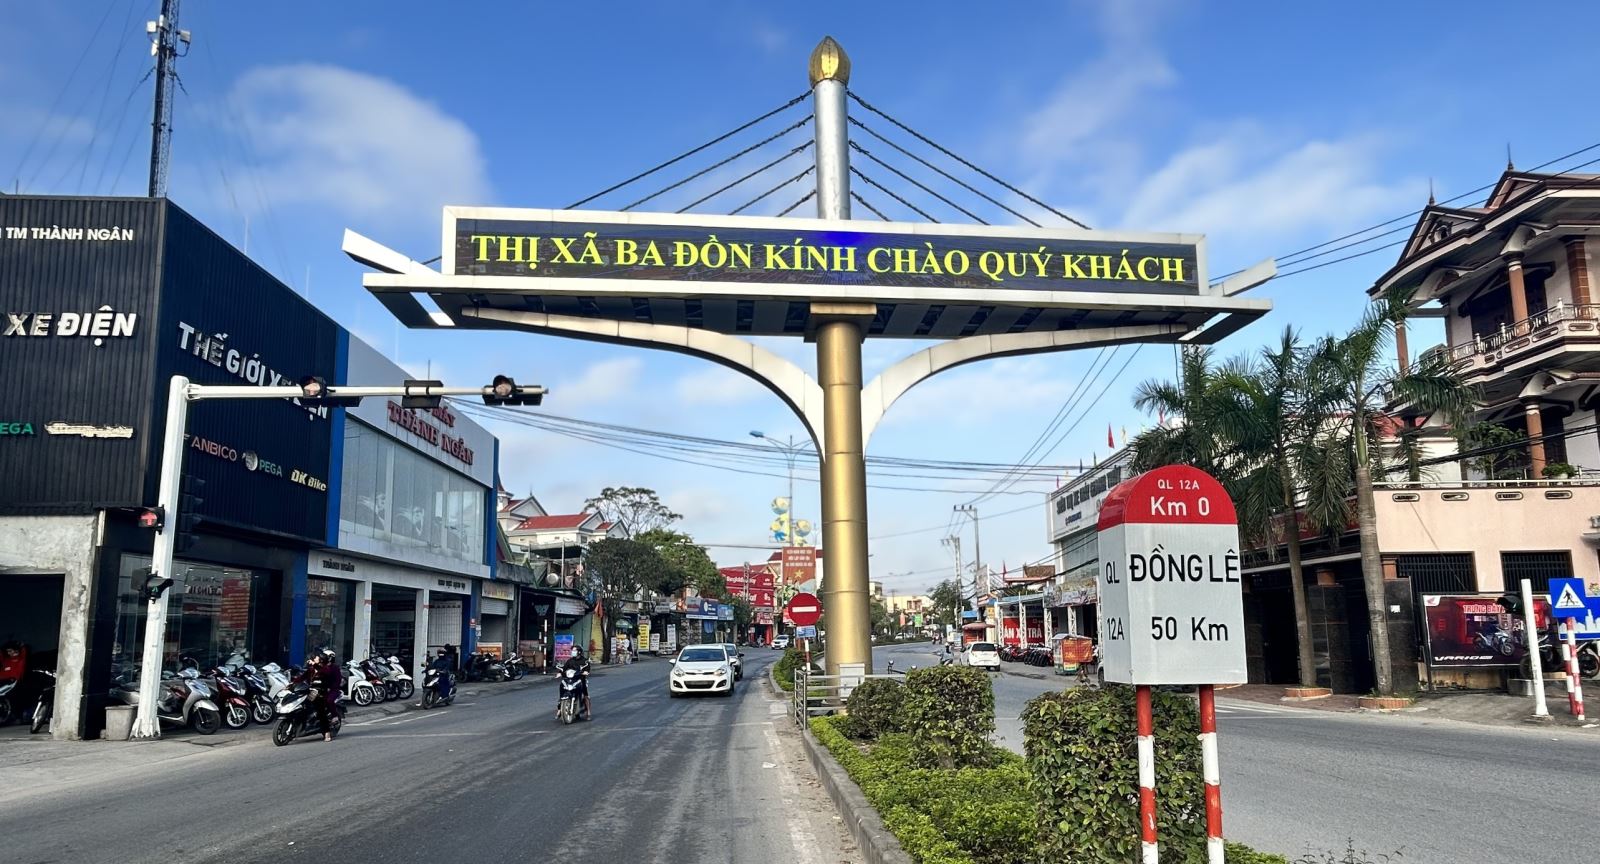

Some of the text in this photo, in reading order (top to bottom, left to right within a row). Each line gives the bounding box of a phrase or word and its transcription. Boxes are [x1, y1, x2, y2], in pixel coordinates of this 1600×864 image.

[6, 225, 134, 241] TM THÀNH NGÂN
[471, 231, 1186, 282] THỊ XÃ BA ĐỒN KÍNH CHÀO QUÝ KHÁCH
[3, 305, 137, 348] XE ĐIỆN
[178, 321, 229, 367] THẾ
[225, 349, 266, 387] GIỚI
[388, 400, 474, 466] THÀNH NGÂN
[191, 436, 238, 462] ANBICO
[259, 459, 283, 478] PEGA
[291, 469, 327, 491] DK Bike
[1158, 478, 1200, 490] QL 12A
[1151, 496, 1211, 516] Km 0
[1105, 562, 1120, 585] QL
[1129, 544, 1240, 583] ĐỒNG LÊ
[1106, 617, 1125, 641] 12A
[1151, 616, 1229, 641] 50 Km
